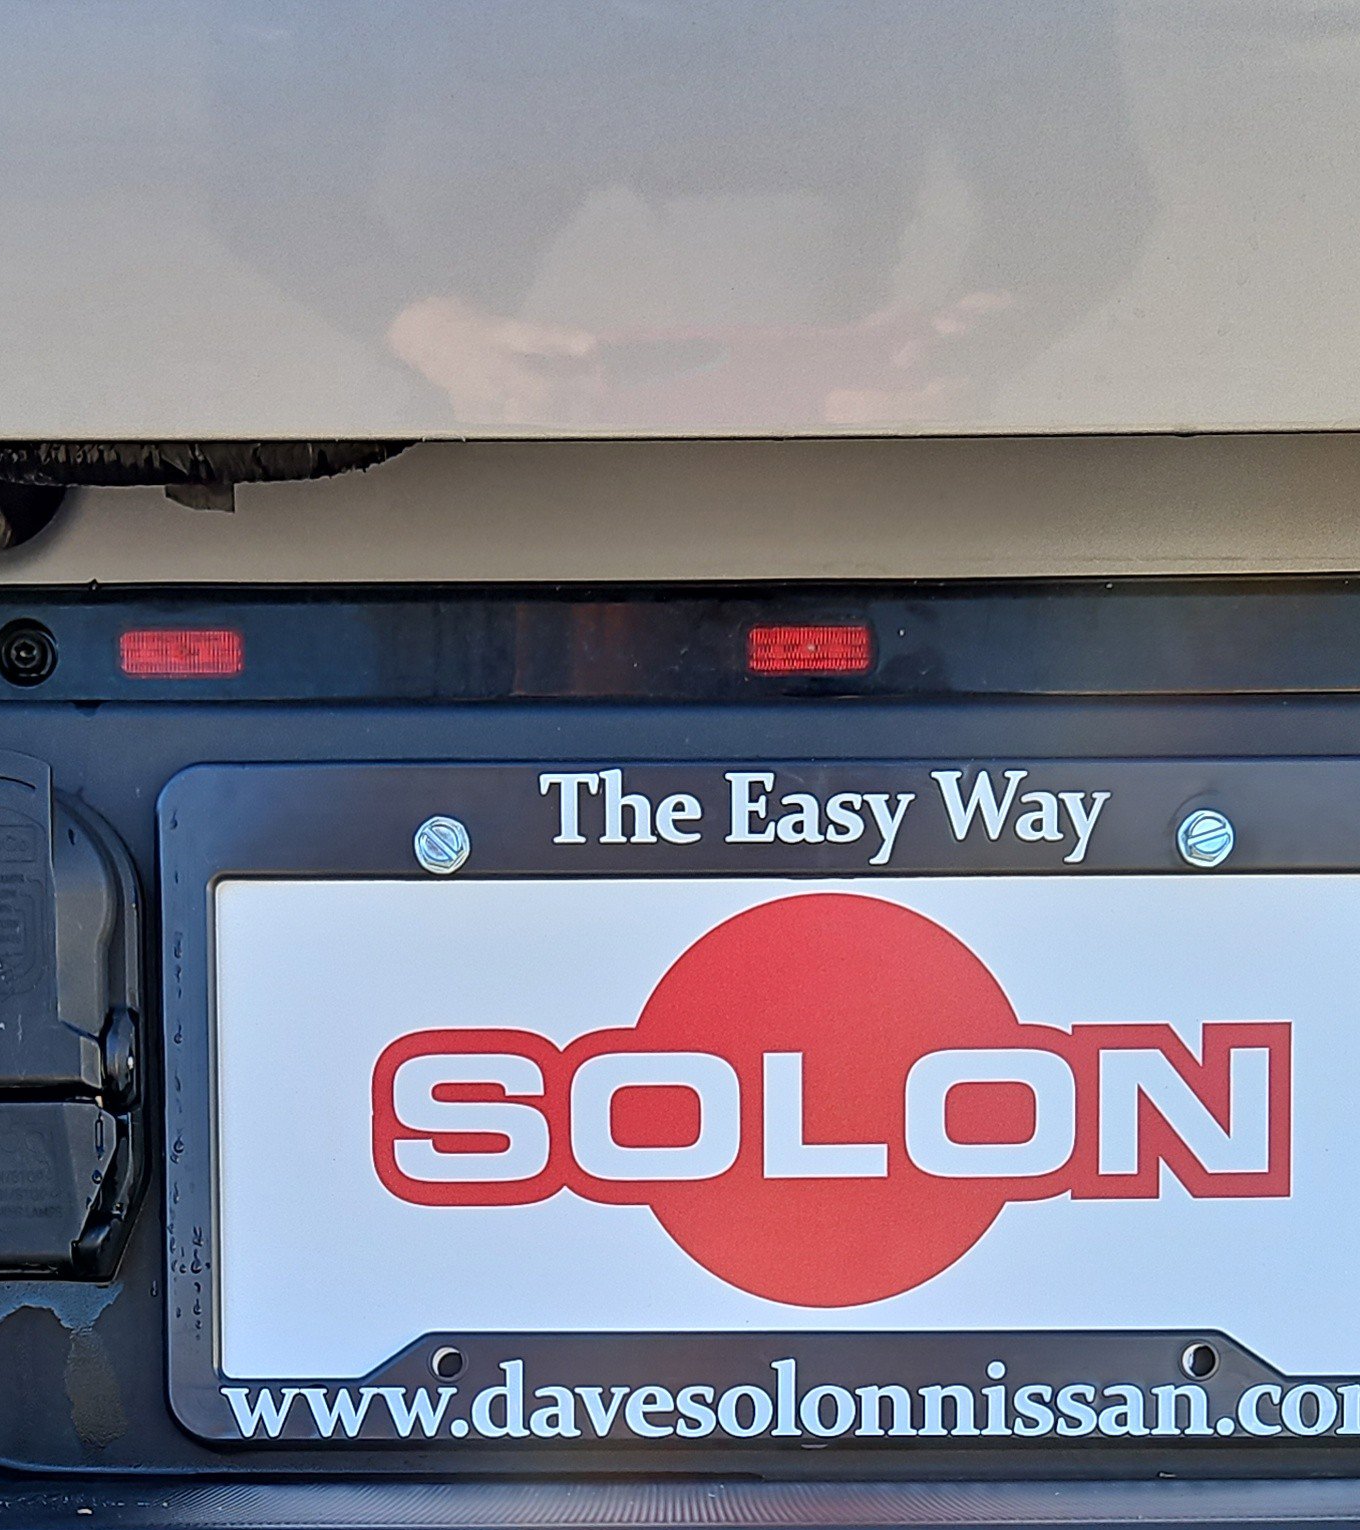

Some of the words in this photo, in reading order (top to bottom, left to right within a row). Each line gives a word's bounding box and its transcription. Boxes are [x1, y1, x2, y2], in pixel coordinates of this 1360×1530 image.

[539, 768, 703, 845] The
[724, 771, 917, 866] Easy
[930, 769, 1112, 864] Way
[385, 1040, 1278, 1190] SOLON
